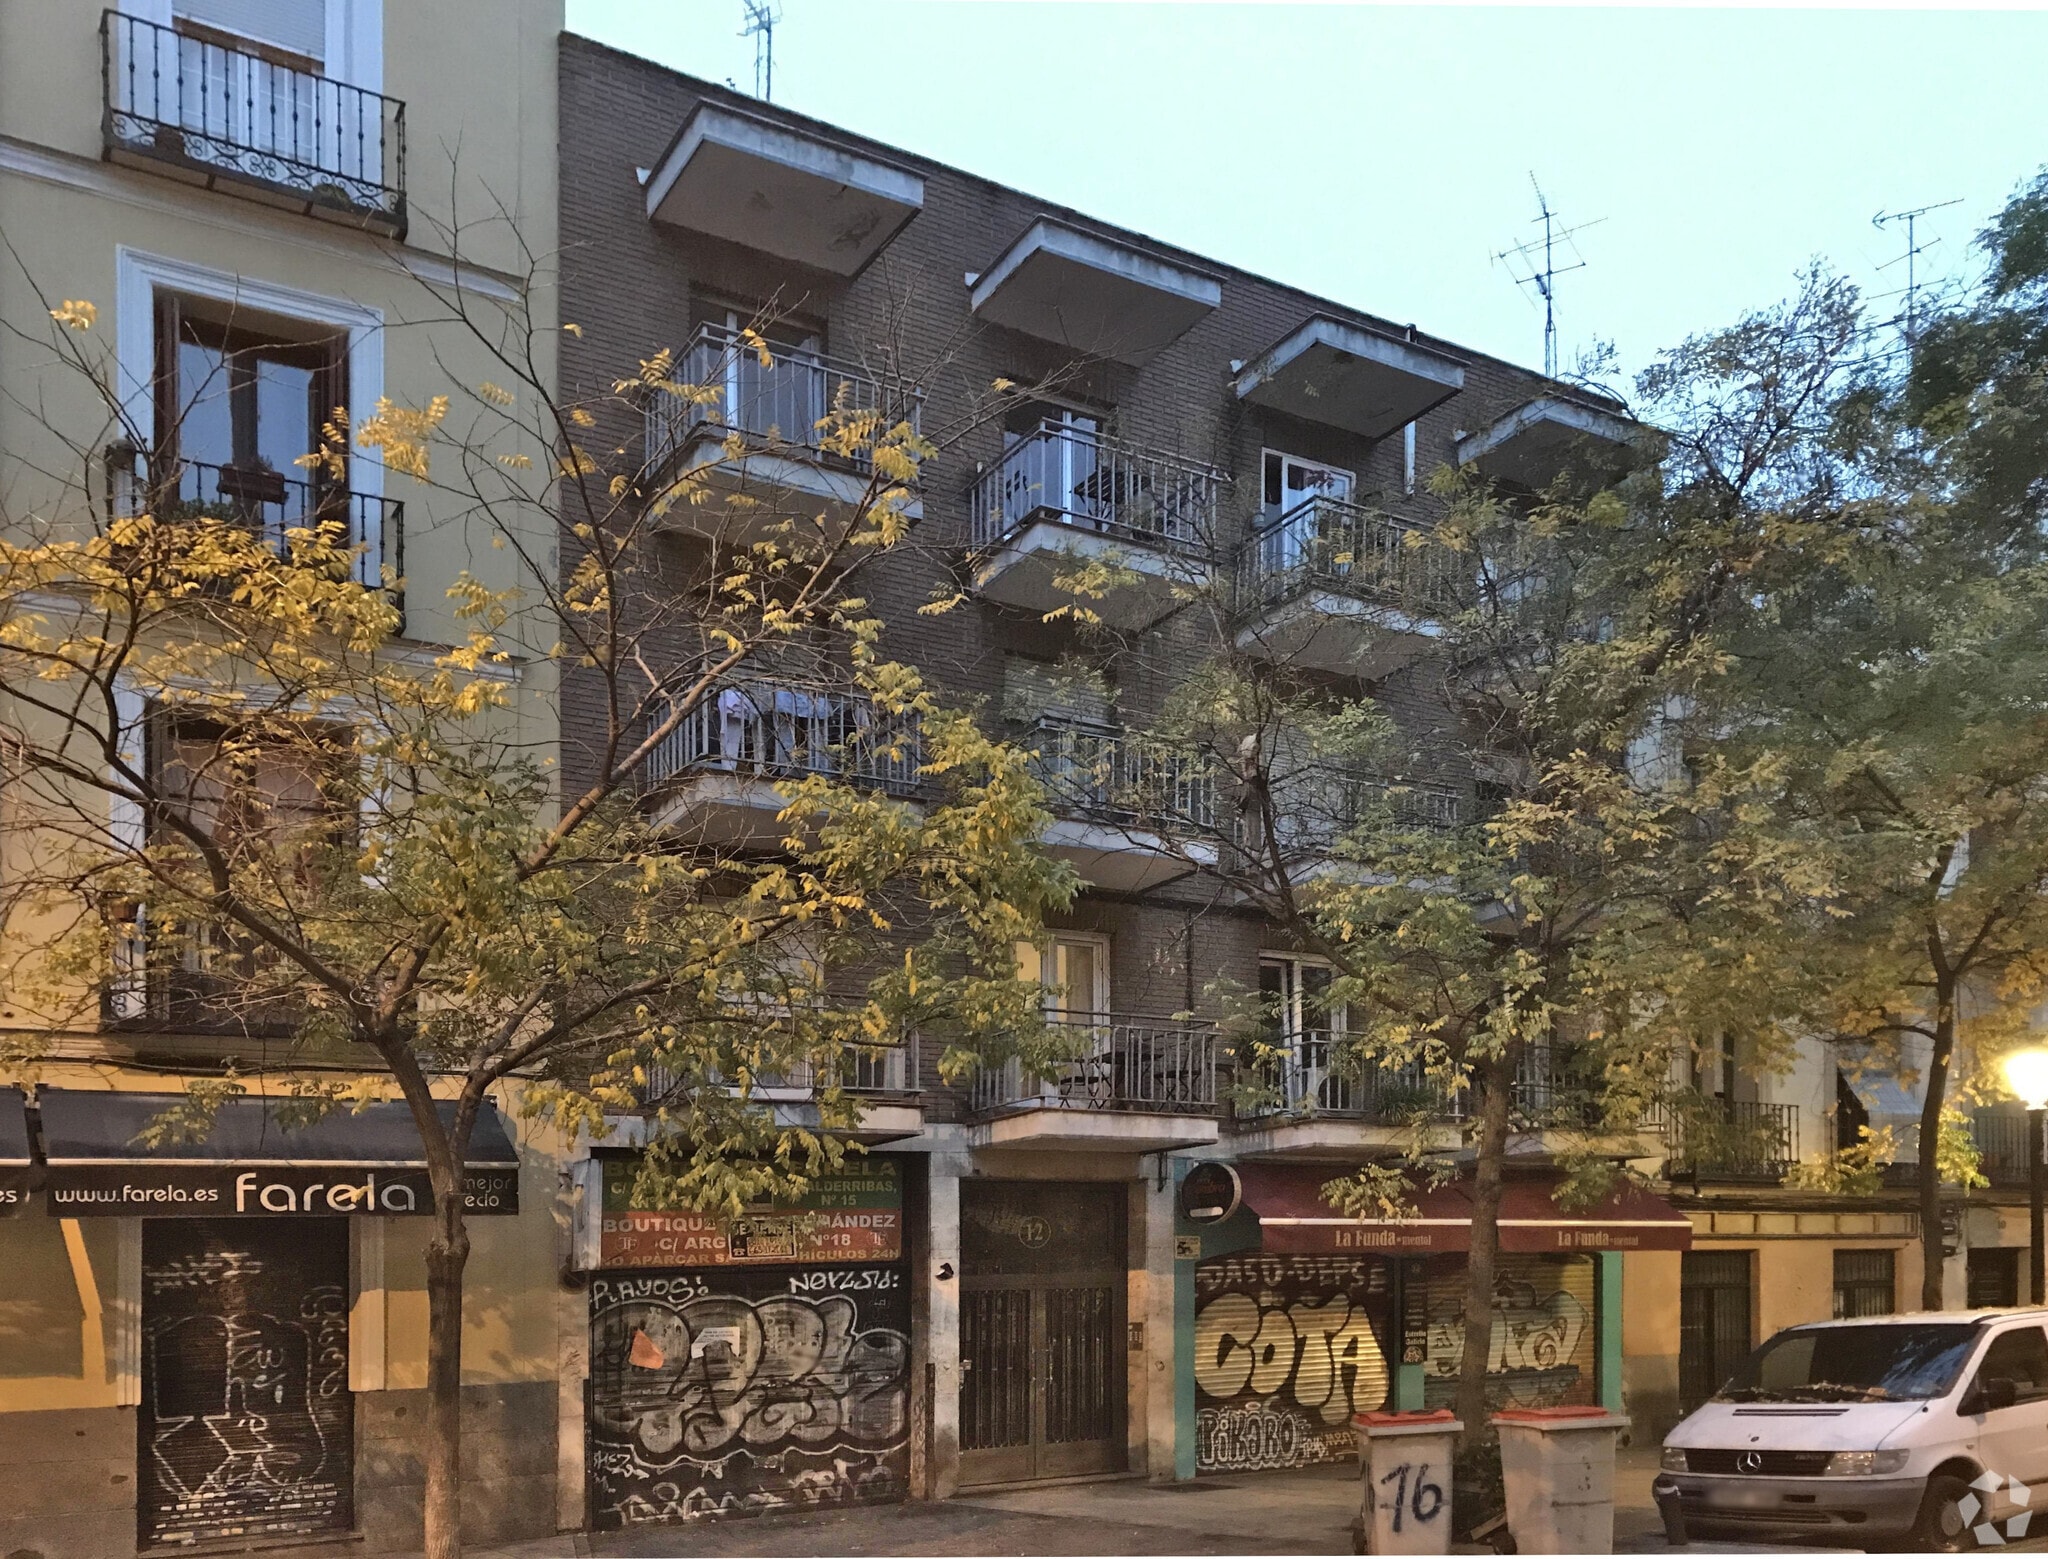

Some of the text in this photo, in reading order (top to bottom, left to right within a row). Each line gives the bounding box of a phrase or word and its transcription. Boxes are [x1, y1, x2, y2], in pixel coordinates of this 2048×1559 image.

[55, 1184, 218, 1203] www.farela.es
[236, 1173, 415, 1212] farela
[804, 1180, 897, 1193] ALDERRIBAS,
